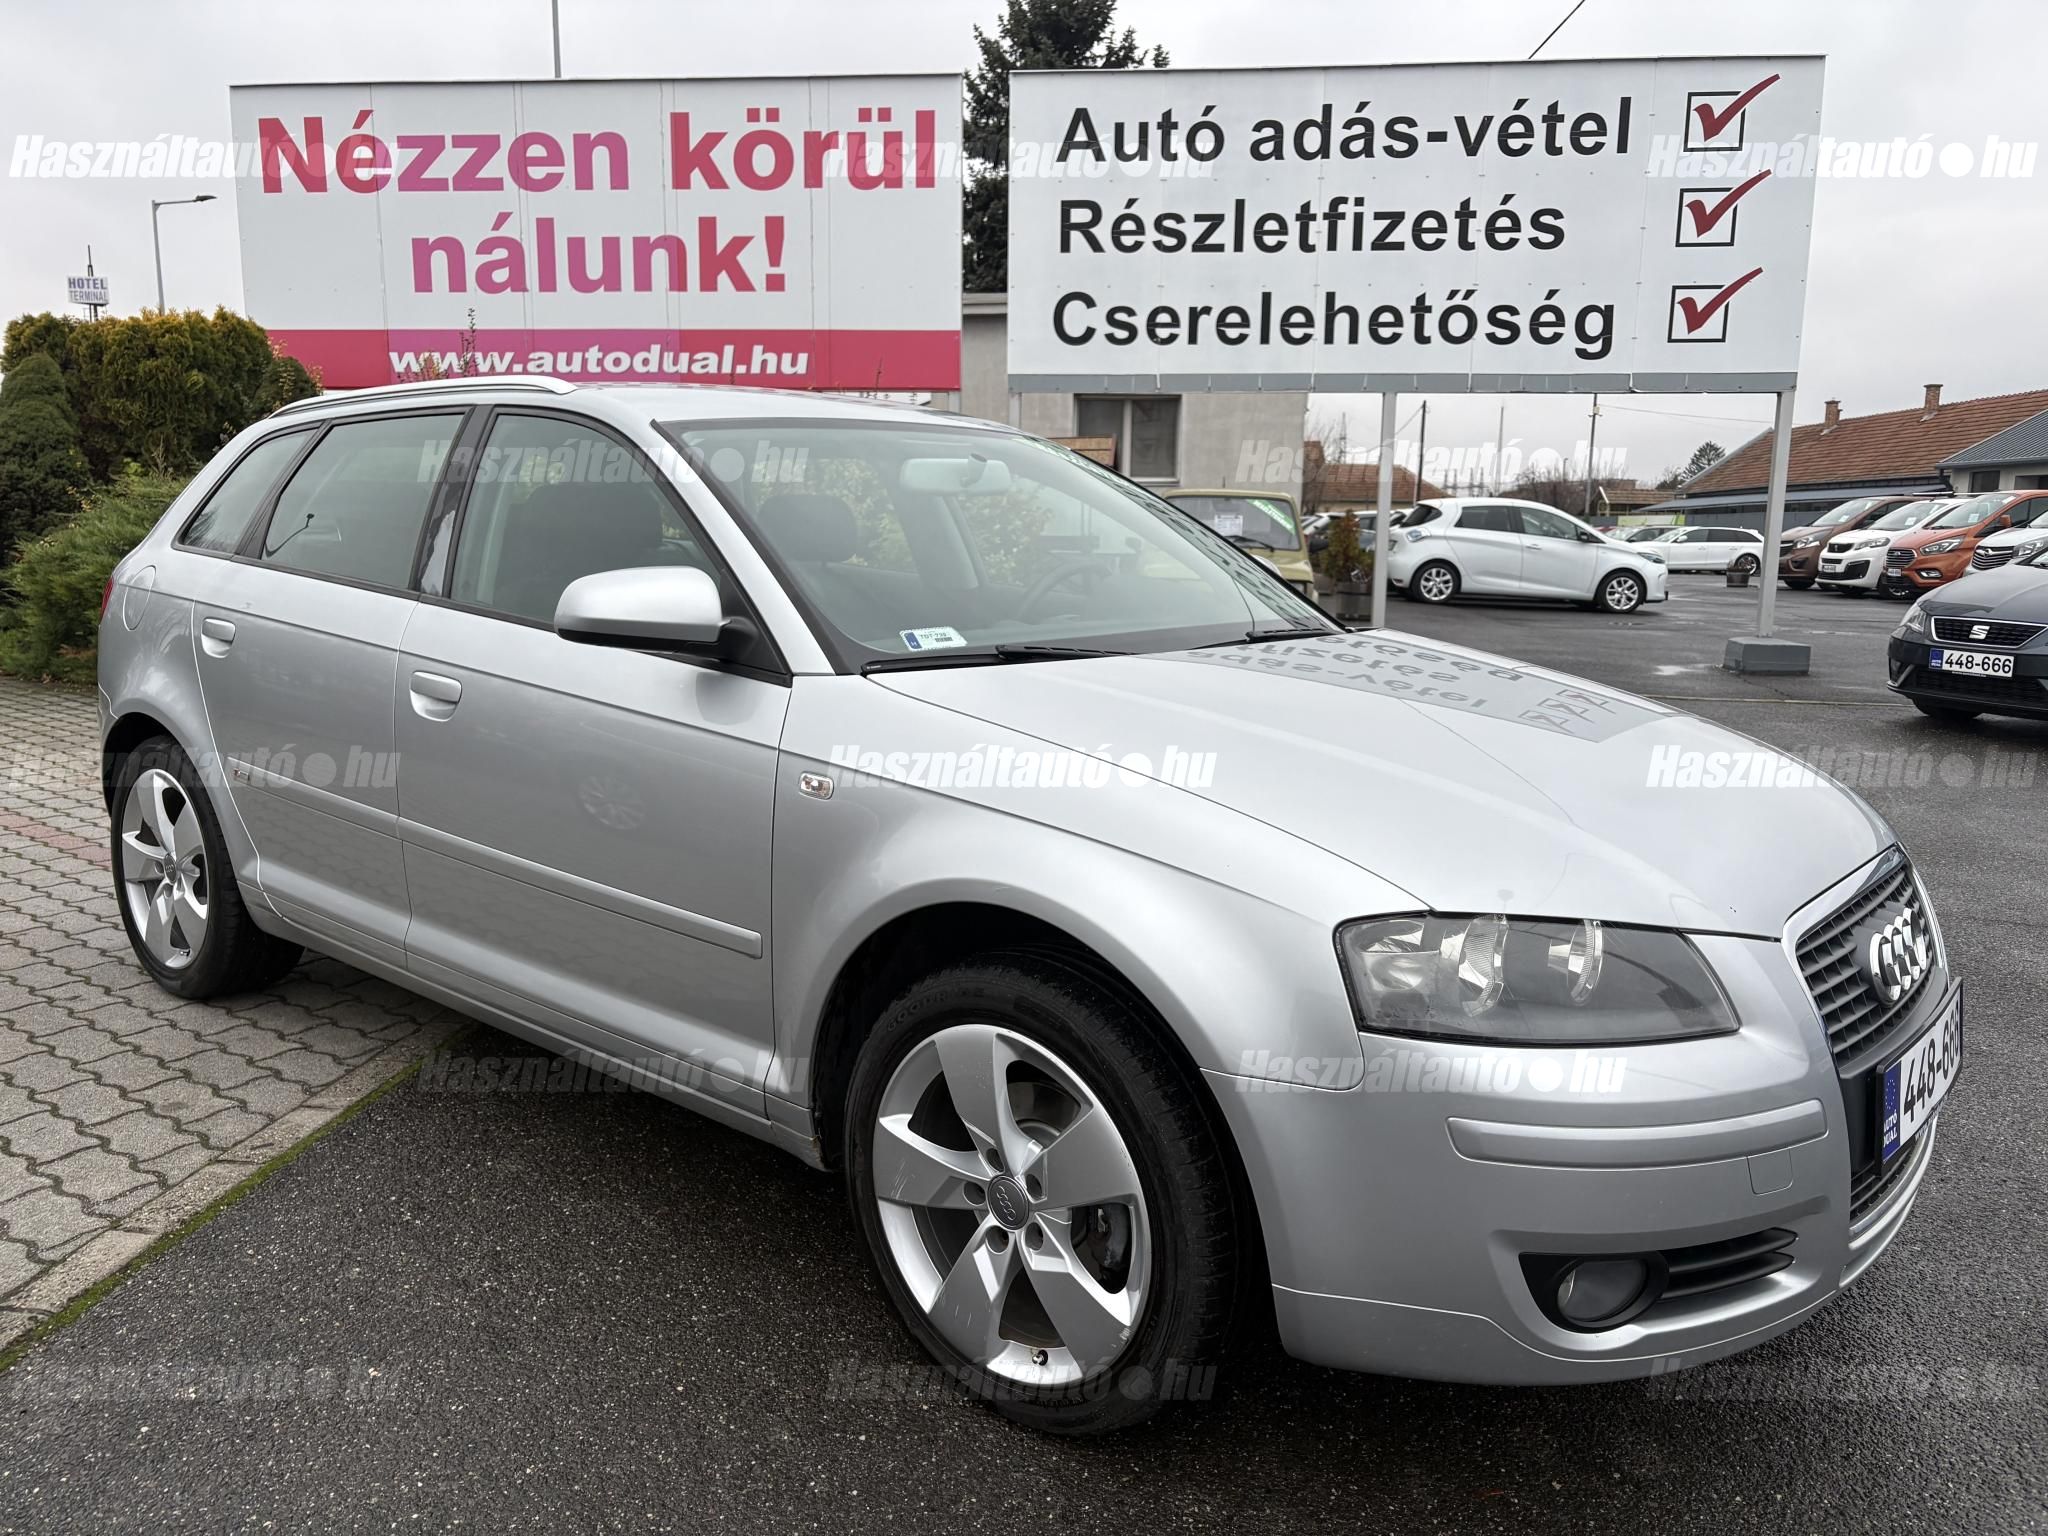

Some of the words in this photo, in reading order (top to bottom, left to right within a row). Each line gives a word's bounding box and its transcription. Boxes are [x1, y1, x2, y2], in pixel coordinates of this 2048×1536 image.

[258, 109, 629, 194] Nézzen
[671, 107, 935, 191] körül
[1056, 104, 1225, 163] Autó
[1249, 96, 1632, 162] adás-vétel
[411, 212, 787, 294] nálunk!
[1059, 193, 1566, 254] Részletfizetés
[68, 277, 107, 290] HOTEL
[69, 290, 108, 302] TERMINAL
[1053, 288, 1616, 361] Cserelehetőség
[388, 343, 809, 375] www.autodual.hu
[1944, 652, 2012, 674] 448-666
